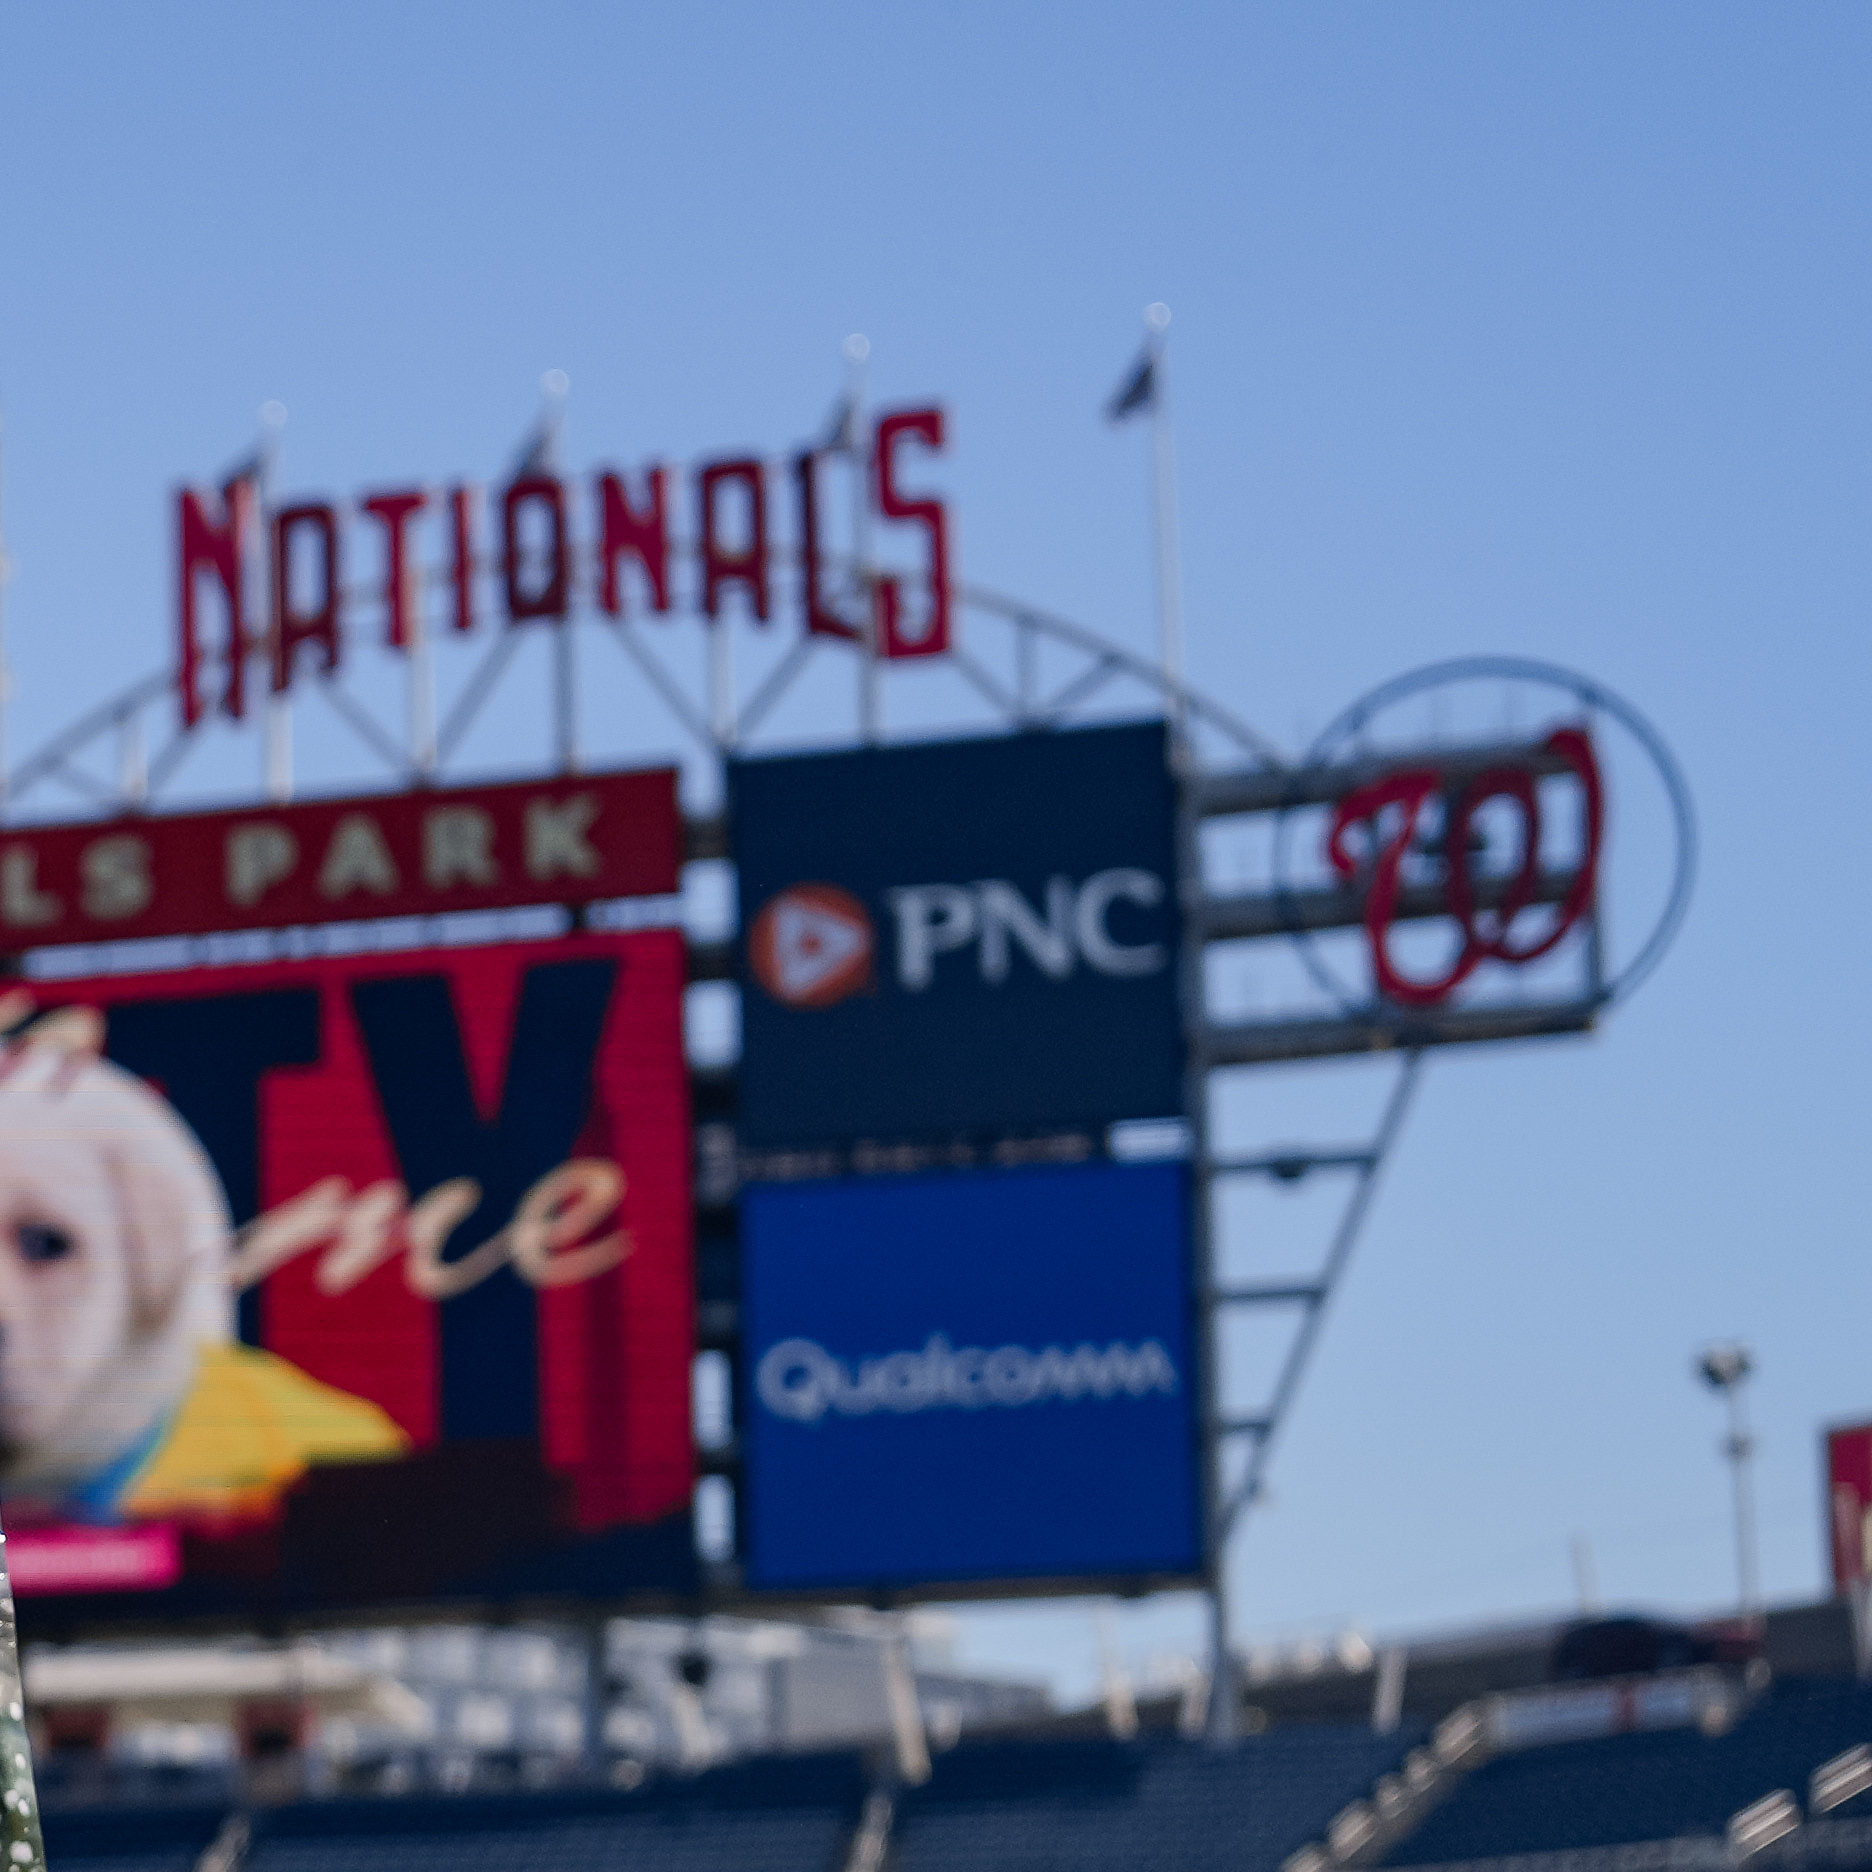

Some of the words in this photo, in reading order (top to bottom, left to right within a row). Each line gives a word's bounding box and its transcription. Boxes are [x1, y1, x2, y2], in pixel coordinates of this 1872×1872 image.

[173, 402, 953, 728] NATIONALS
[225, 793, 602, 903] PARK
[887, 867, 1170, 990] PNC
[760, 1330, 1179, 1423] Qualcomm
